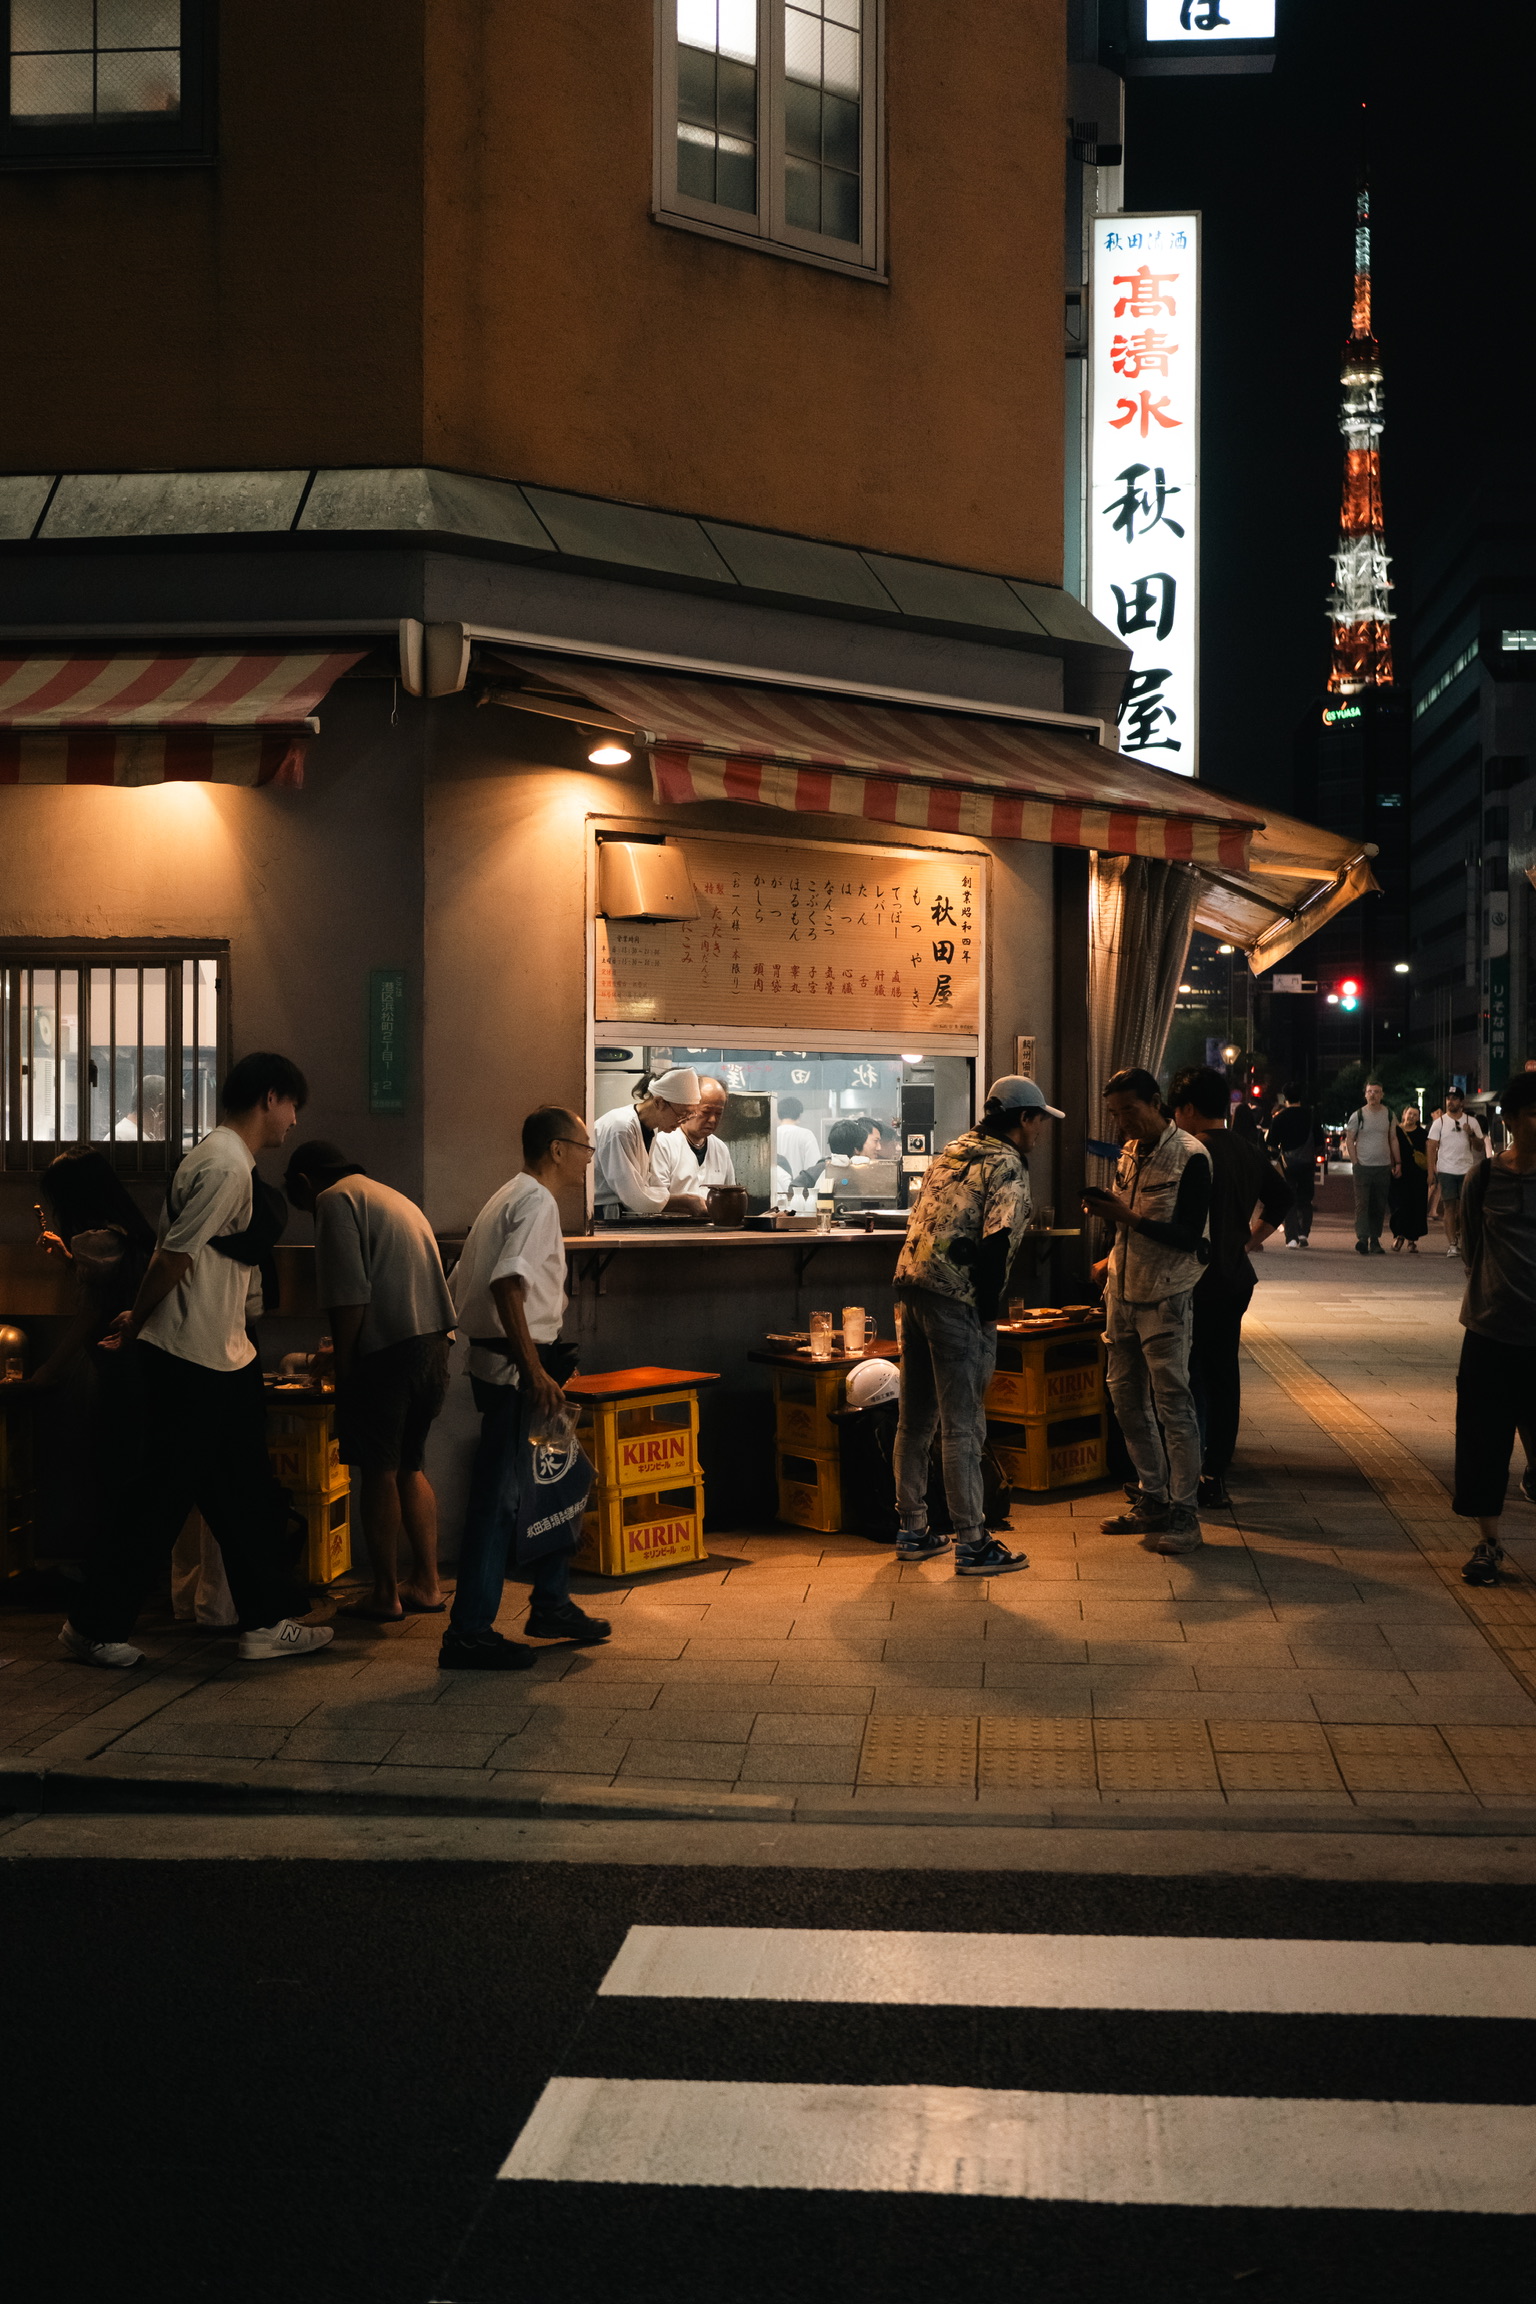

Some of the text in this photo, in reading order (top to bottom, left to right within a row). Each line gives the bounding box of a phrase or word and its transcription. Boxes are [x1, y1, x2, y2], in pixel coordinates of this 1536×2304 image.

[1102, 463, 1186, 753] 秋田屋
[1336, 706, 1361, 720] YUASA
[754, 874, 766, 924] かしら
[770, 876, 783, 918] がつ
[789, 878, 801, 941] ほるもん
[806, 880, 819, 941] こぶくろ
[823, 880, 835, 936] なんこつ
[841, 883, 853, 924] はつ
[857, 883, 868, 926] たん
[874, 885, 885, 925] レバー
[712, 906, 722, 958] たたき
[962, 876, 972, 964] 創業昭和四年
[929, 894, 957, 1009] 秋田屋
[808, 966, 818, 994] 子宮
[859, 974, 869, 988] 舌
[891, 970, 902, 998] 直腸
[1047, 1370, 1094, 1397] KIRIN
[623, 1436, 685, 1466] KIRIN
[638, 1459, 671, 1473] キリンビール
[1050, 1445, 1097, 1472] KIRIN
[628, 1520, 690, 1553] KIRIN
[643, 1544, 678, 1560] キリンビール
[281, 1624, 301, 1642] N
